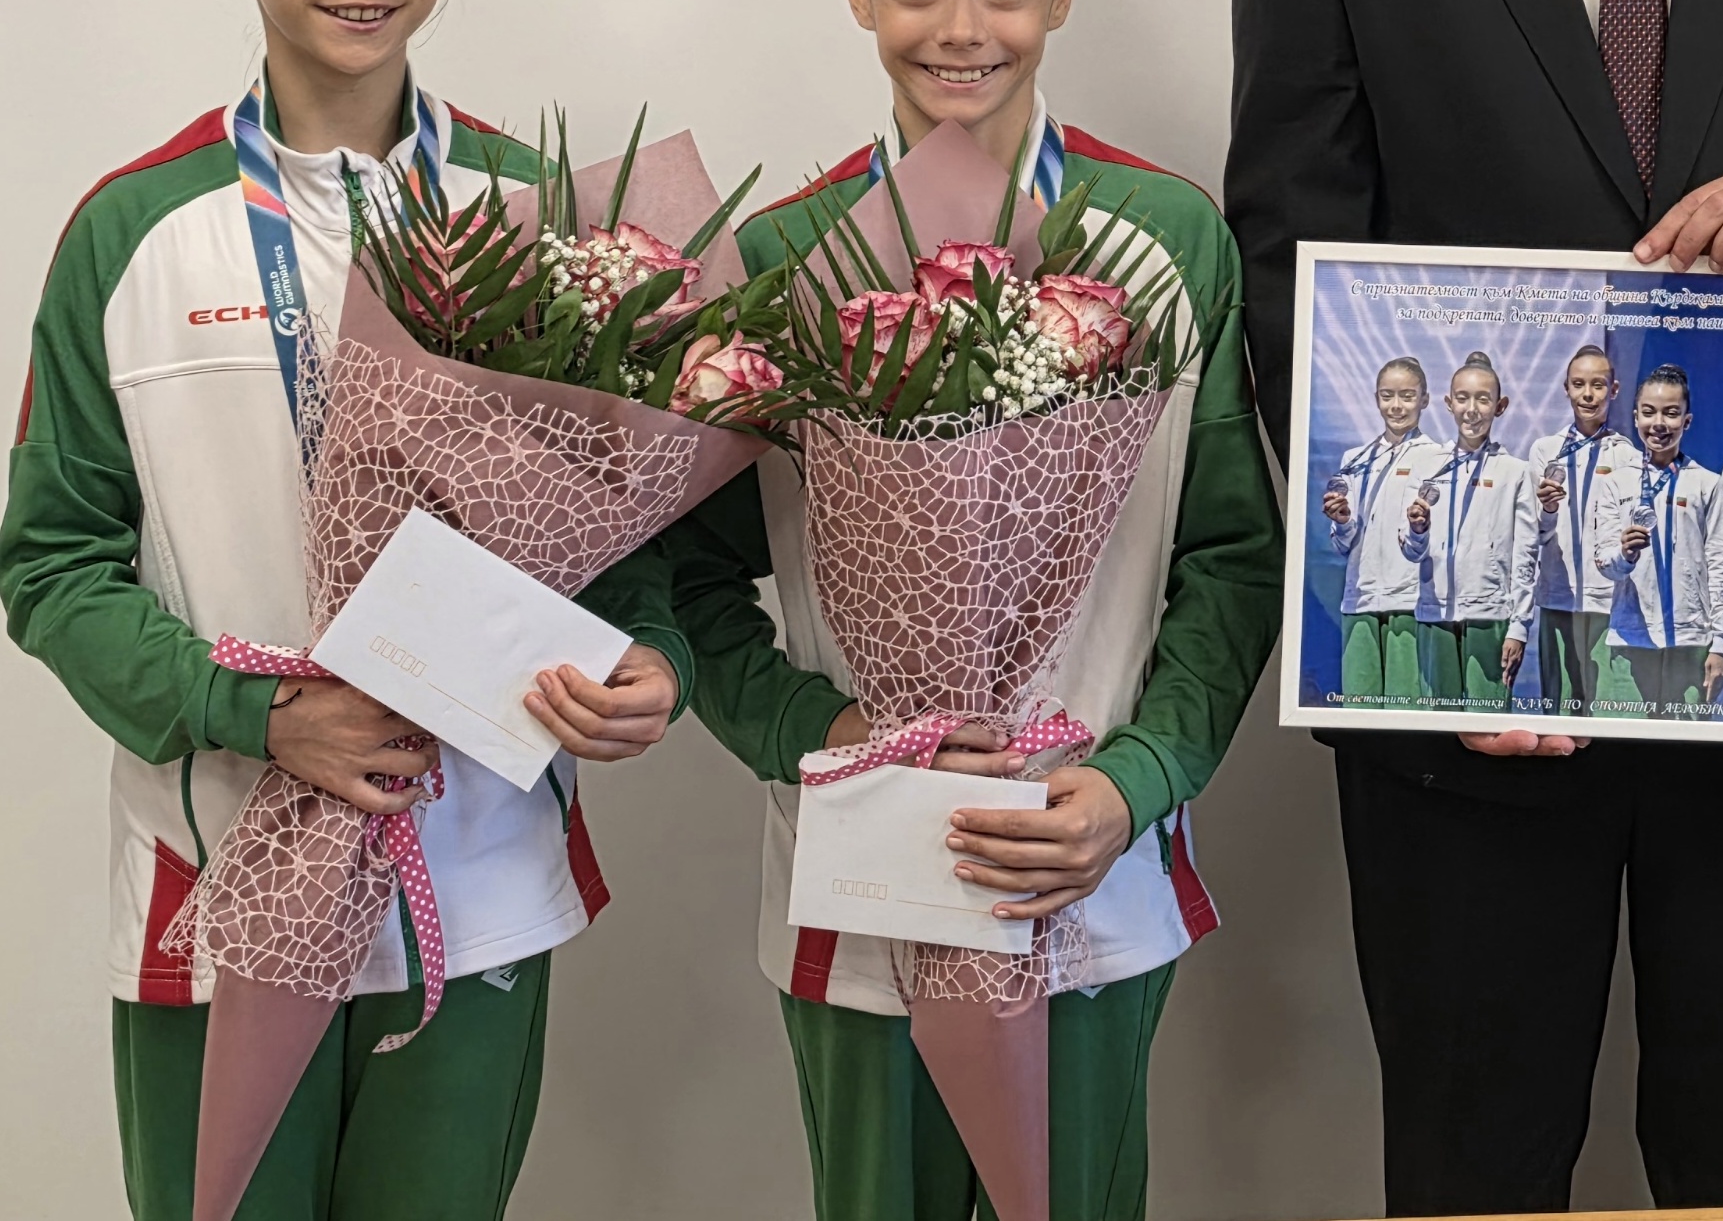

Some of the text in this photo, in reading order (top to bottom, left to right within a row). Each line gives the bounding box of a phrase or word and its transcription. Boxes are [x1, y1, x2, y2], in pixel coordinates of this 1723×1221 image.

[274, 245, 294, 305] GYMNASTICS
[270, 270, 284, 308] WORLD
[1351, 279, 1363, 295] С
[1365, 282, 1478, 299] признателност
[1482, 286, 1513, 301] към
[1515, 284, 1568, 301] Кмета
[1571, 289, 1589, 301] на
[1593, 286, 1648, 305] община
[1397, 307, 1413, 320] за
[1417, 304, 1506, 325] подкрепата,
[1510, 306, 1585, 327] доверието
[1588, 314, 1599, 325] и
[1601, 313, 1660, 330] приноса
[1326, 691, 1345, 703] От
